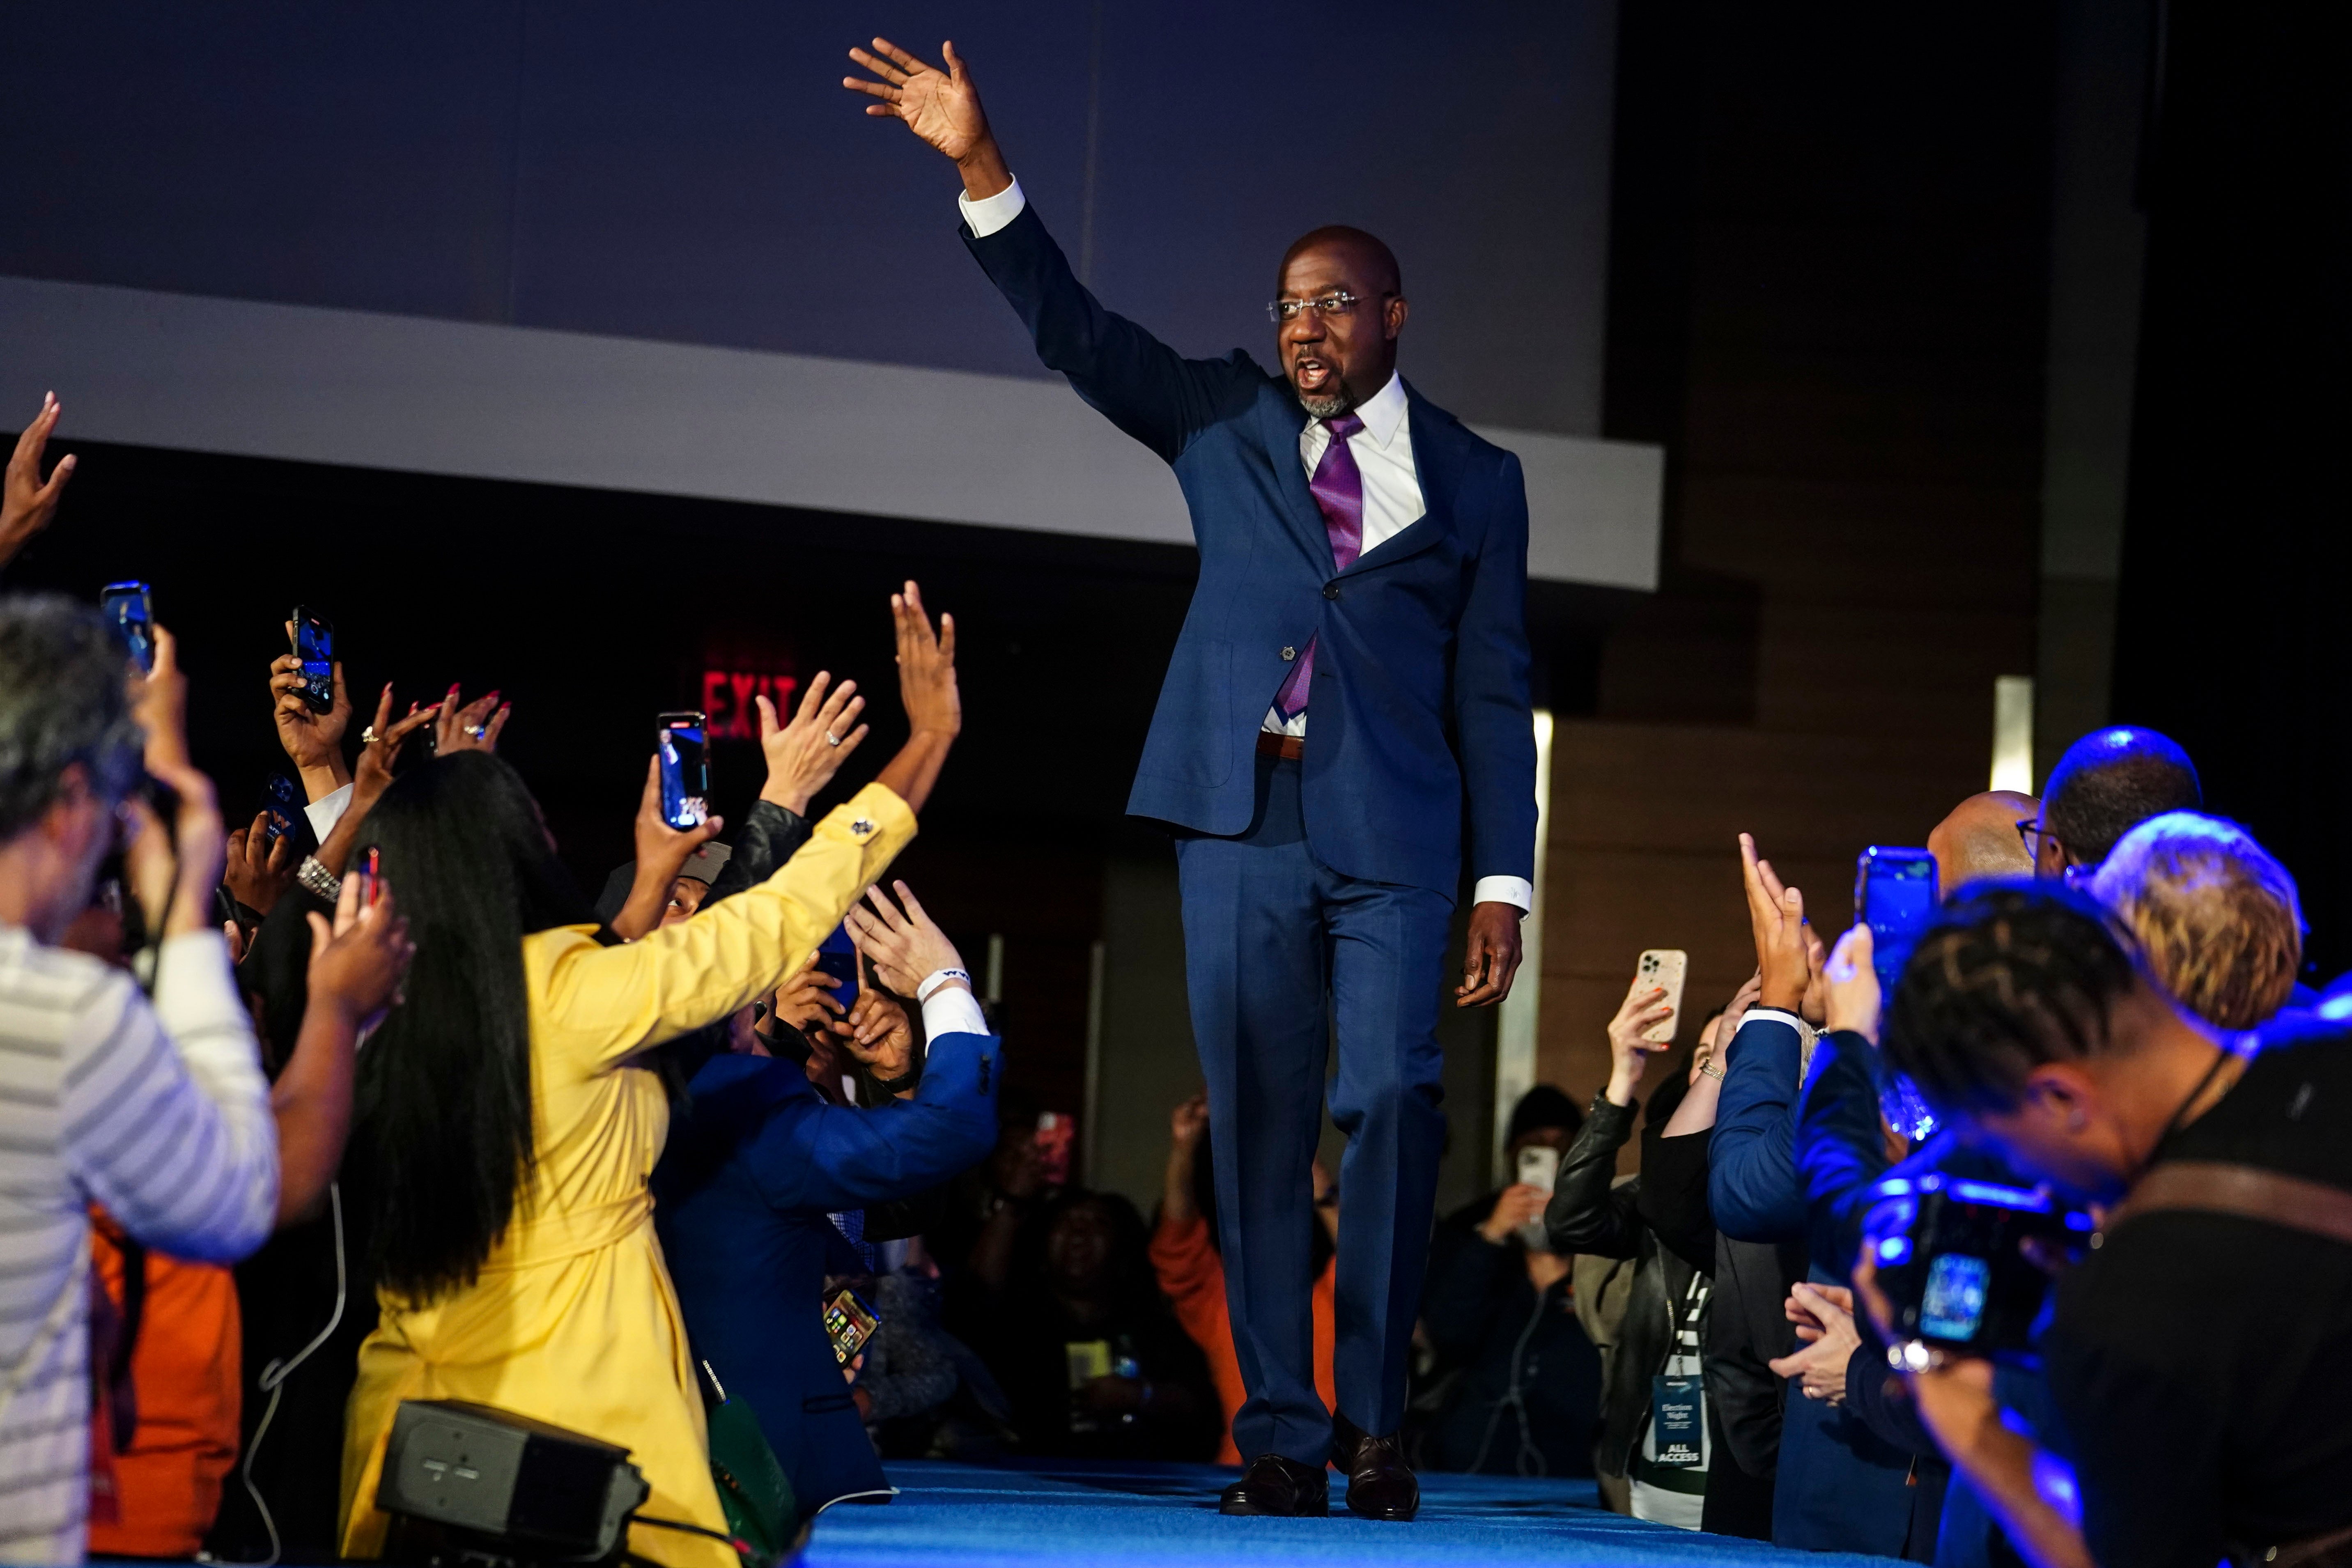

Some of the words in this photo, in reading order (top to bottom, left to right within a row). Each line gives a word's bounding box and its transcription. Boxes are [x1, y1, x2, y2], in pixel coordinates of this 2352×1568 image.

[1661, 1403, 1693, 1412] Election
[1666, 1411, 1689, 1421] Night
[1668, 1444, 1690, 1453] ALL
[1658, 1453, 1700, 1462] ACCESS
